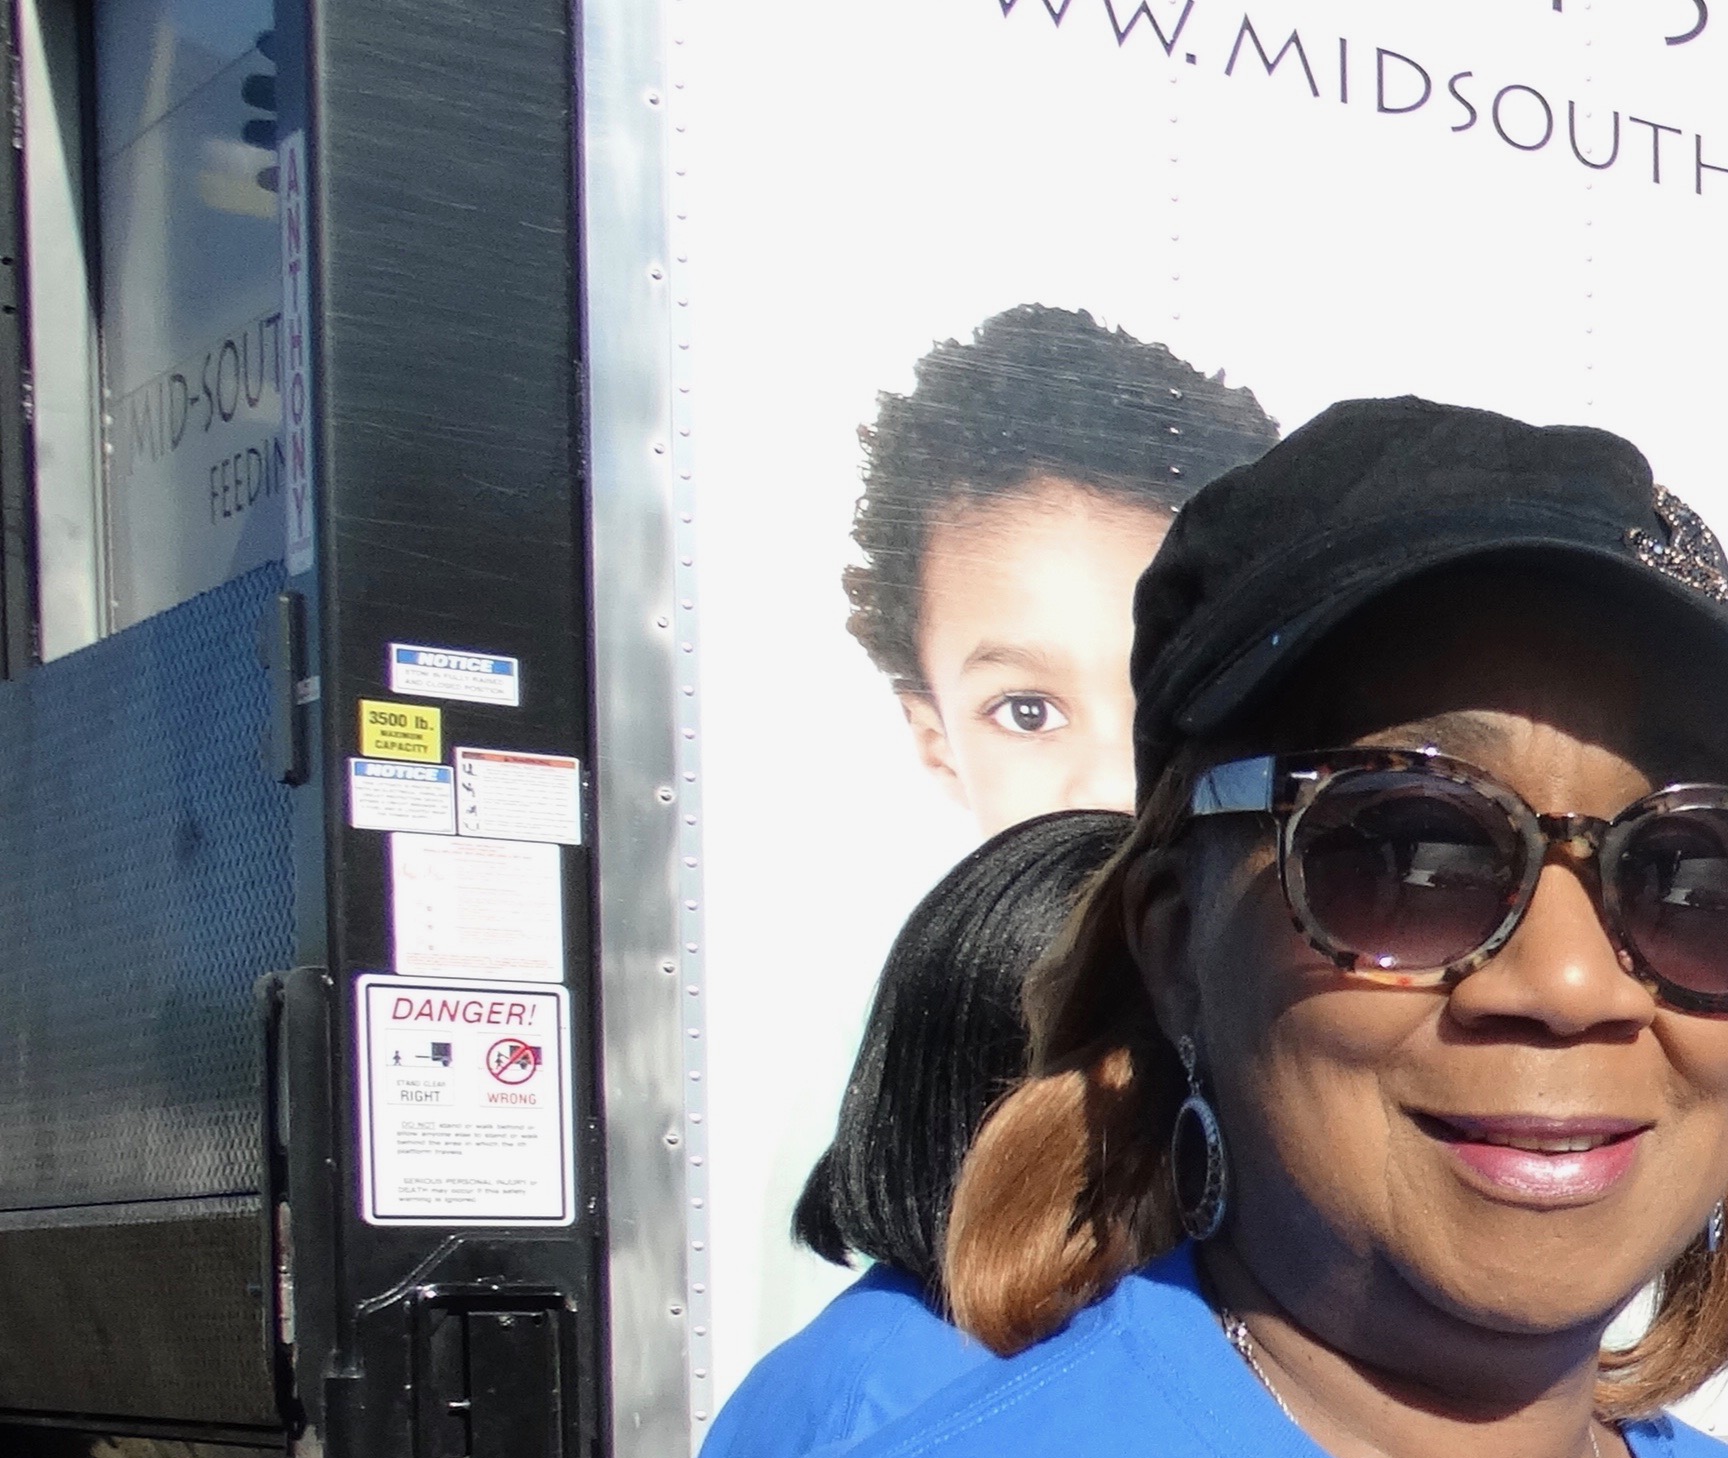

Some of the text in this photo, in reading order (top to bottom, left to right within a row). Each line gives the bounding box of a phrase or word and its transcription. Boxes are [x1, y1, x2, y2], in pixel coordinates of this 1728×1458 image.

[417, 651, 495, 673] NOTICE
[369, 710, 407, 727] 3500
[380, 730, 423, 741] MAXIMUM
[374, 739, 428, 754] CAPACITY
[365, 762, 440, 782] NOTICE
[392, 997, 537, 1026] DANGER!
[400, 1090, 441, 1103] RIGHT
[487, 1092, 537, 1105] WRONG
